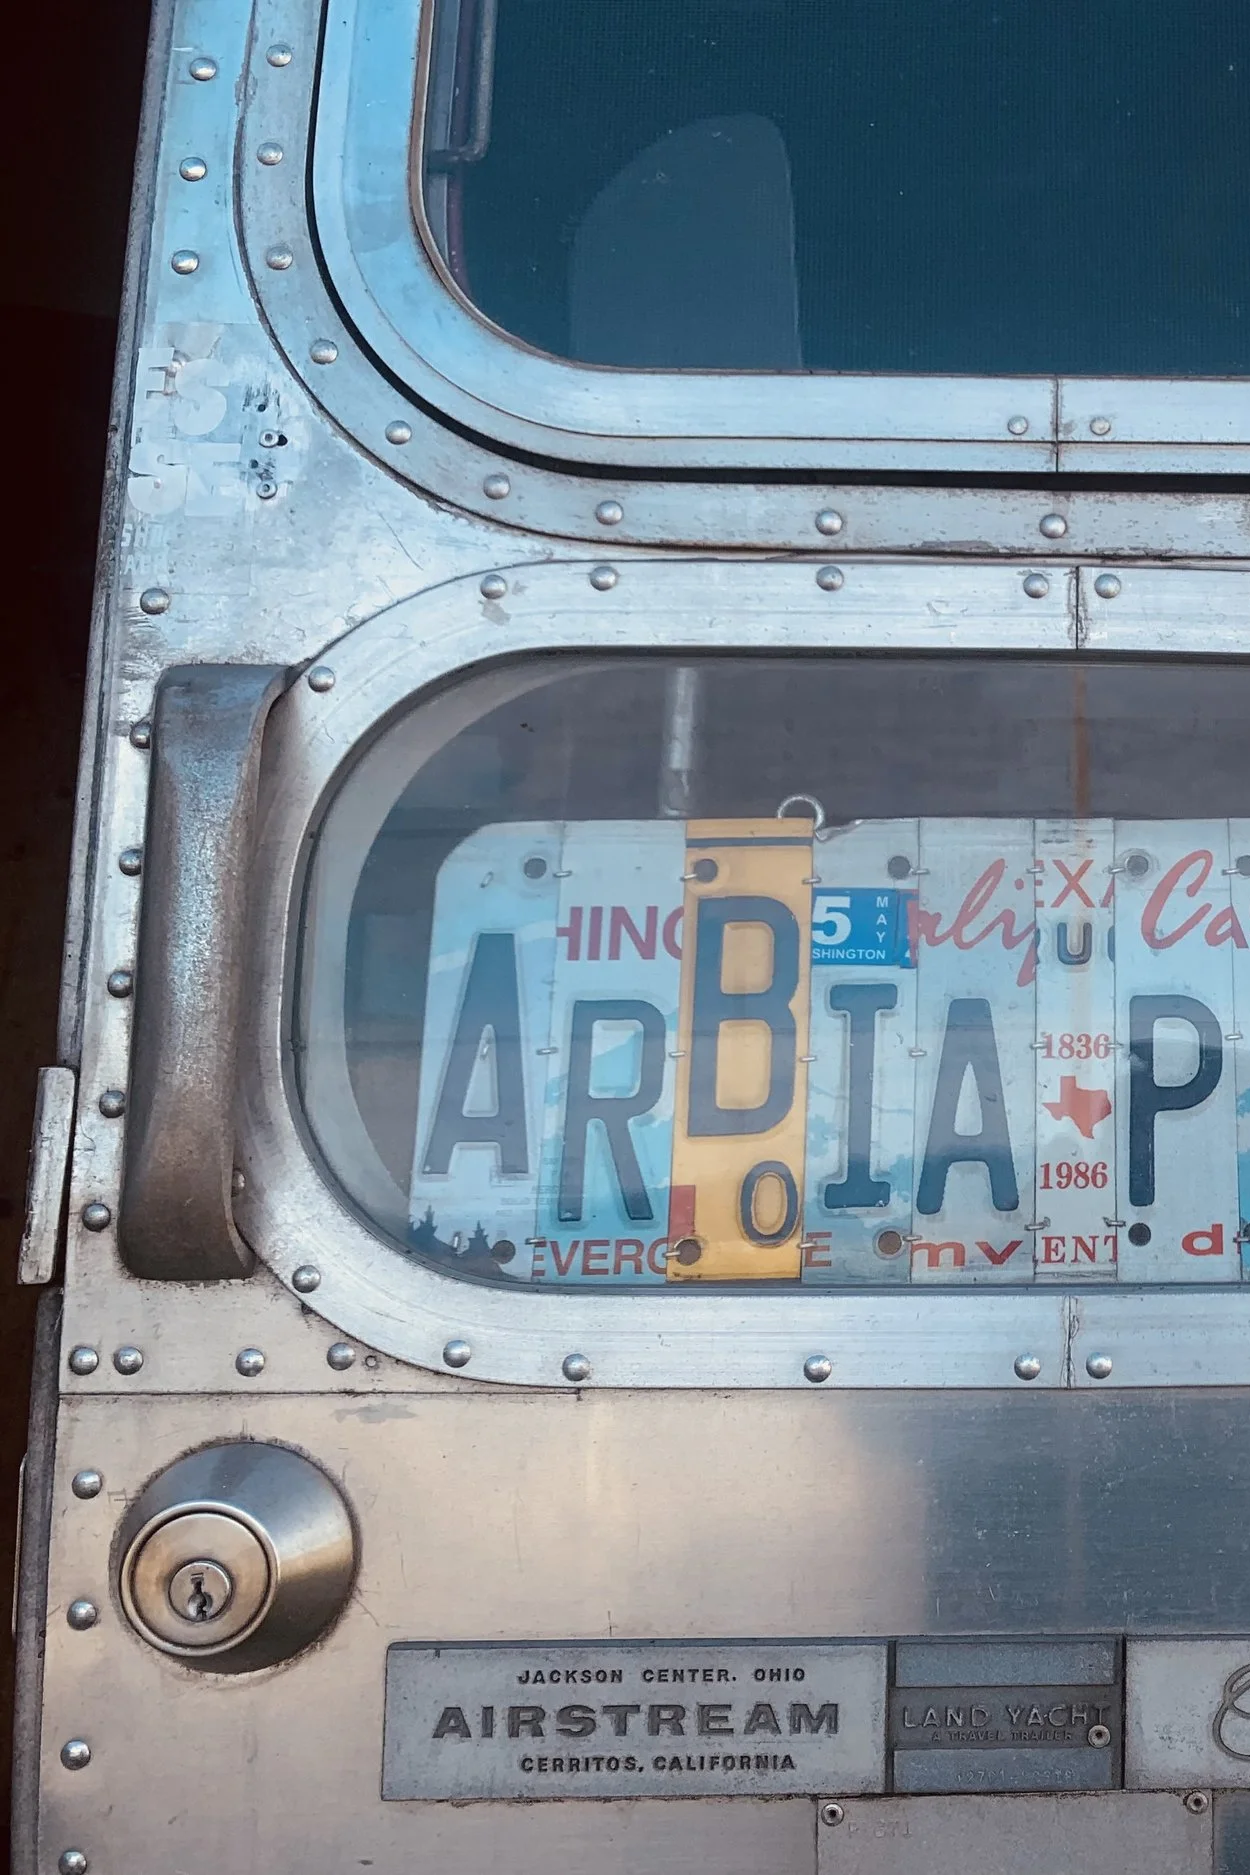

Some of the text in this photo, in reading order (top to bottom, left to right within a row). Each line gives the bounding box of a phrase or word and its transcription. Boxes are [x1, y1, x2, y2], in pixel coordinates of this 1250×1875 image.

[422, 895, 1020, 1222] ARBIA
[1042, 1033, 1111, 1060] 1836
[1040, 1162, 1108, 1190] 1986
[517, 1669, 624, 1684] JACKSON
[753, 1667, 806, 1682] OHIO
[431, 1702, 840, 1740] AIRSTREAM
[903, 1702, 1111, 1729] LAND YACHT
[949, 1730, 1005, 1742] TRAVEL
[1011, 1729, 1074, 1742] TRAILER
[652, 1753, 797, 1773] CALIFORNIA
